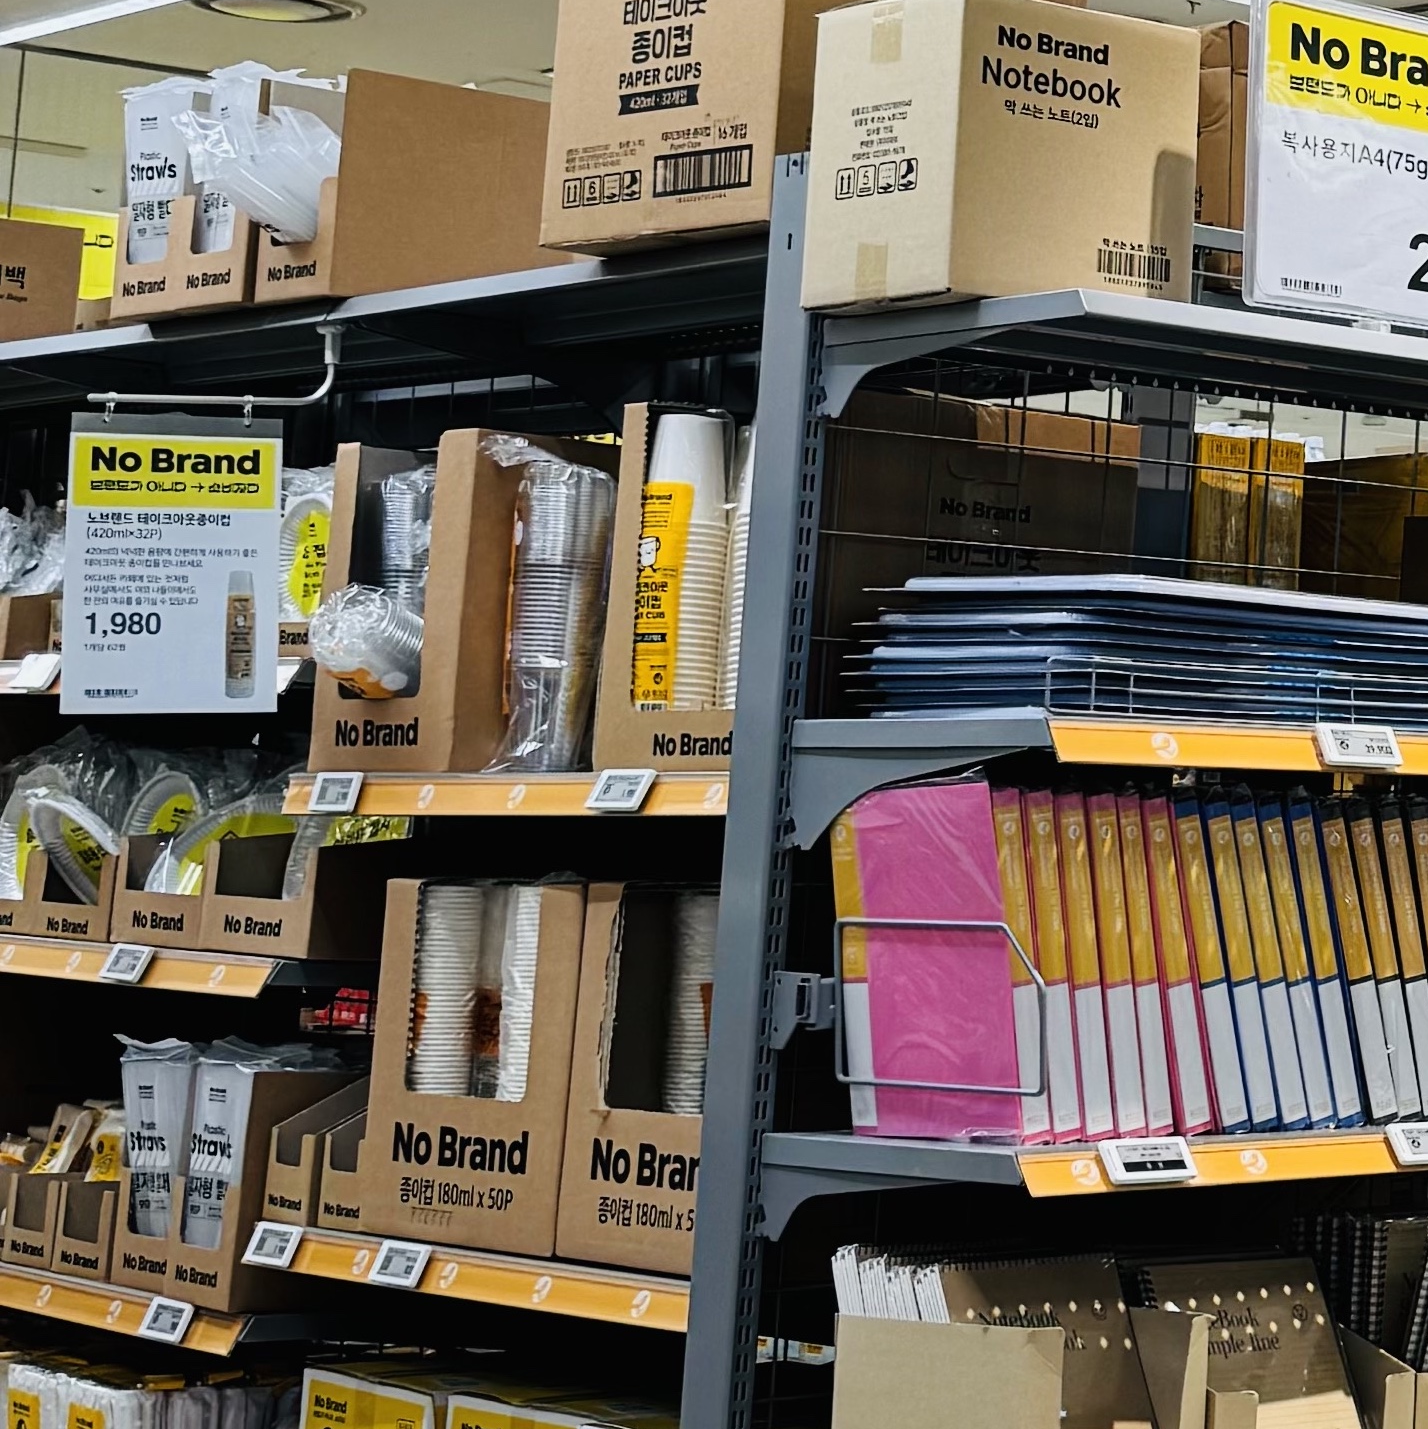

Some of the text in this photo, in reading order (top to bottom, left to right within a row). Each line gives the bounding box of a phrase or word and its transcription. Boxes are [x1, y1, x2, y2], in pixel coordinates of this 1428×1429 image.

[632, 24, 693, 64] 종이컵
[998, 25, 1109, 66] No Brand
[1290, 22, 1350, 71] No
[619, 62, 702, 89] PAPER CUPS
[981, 55, 1121, 109] Notebook
[1004, 99, 1099, 129] 막 쓰는 노트(2입)
[1280, 129, 1428, 180] 복사용지A4(75g
[90, 446, 261, 475] No Brand
[85, 612, 162, 638] 1,980
[335, 716, 420, 748] No Brand
[224, 915, 283, 937] No Brand
[392, 1121, 530, 1175] No Brand
[400, 1176, 514, 1211] 종이컵 180ml x 50P
[598, 1196, 633, 1227] 종이컵
[636, 1202, 672, 1229] 180ml
